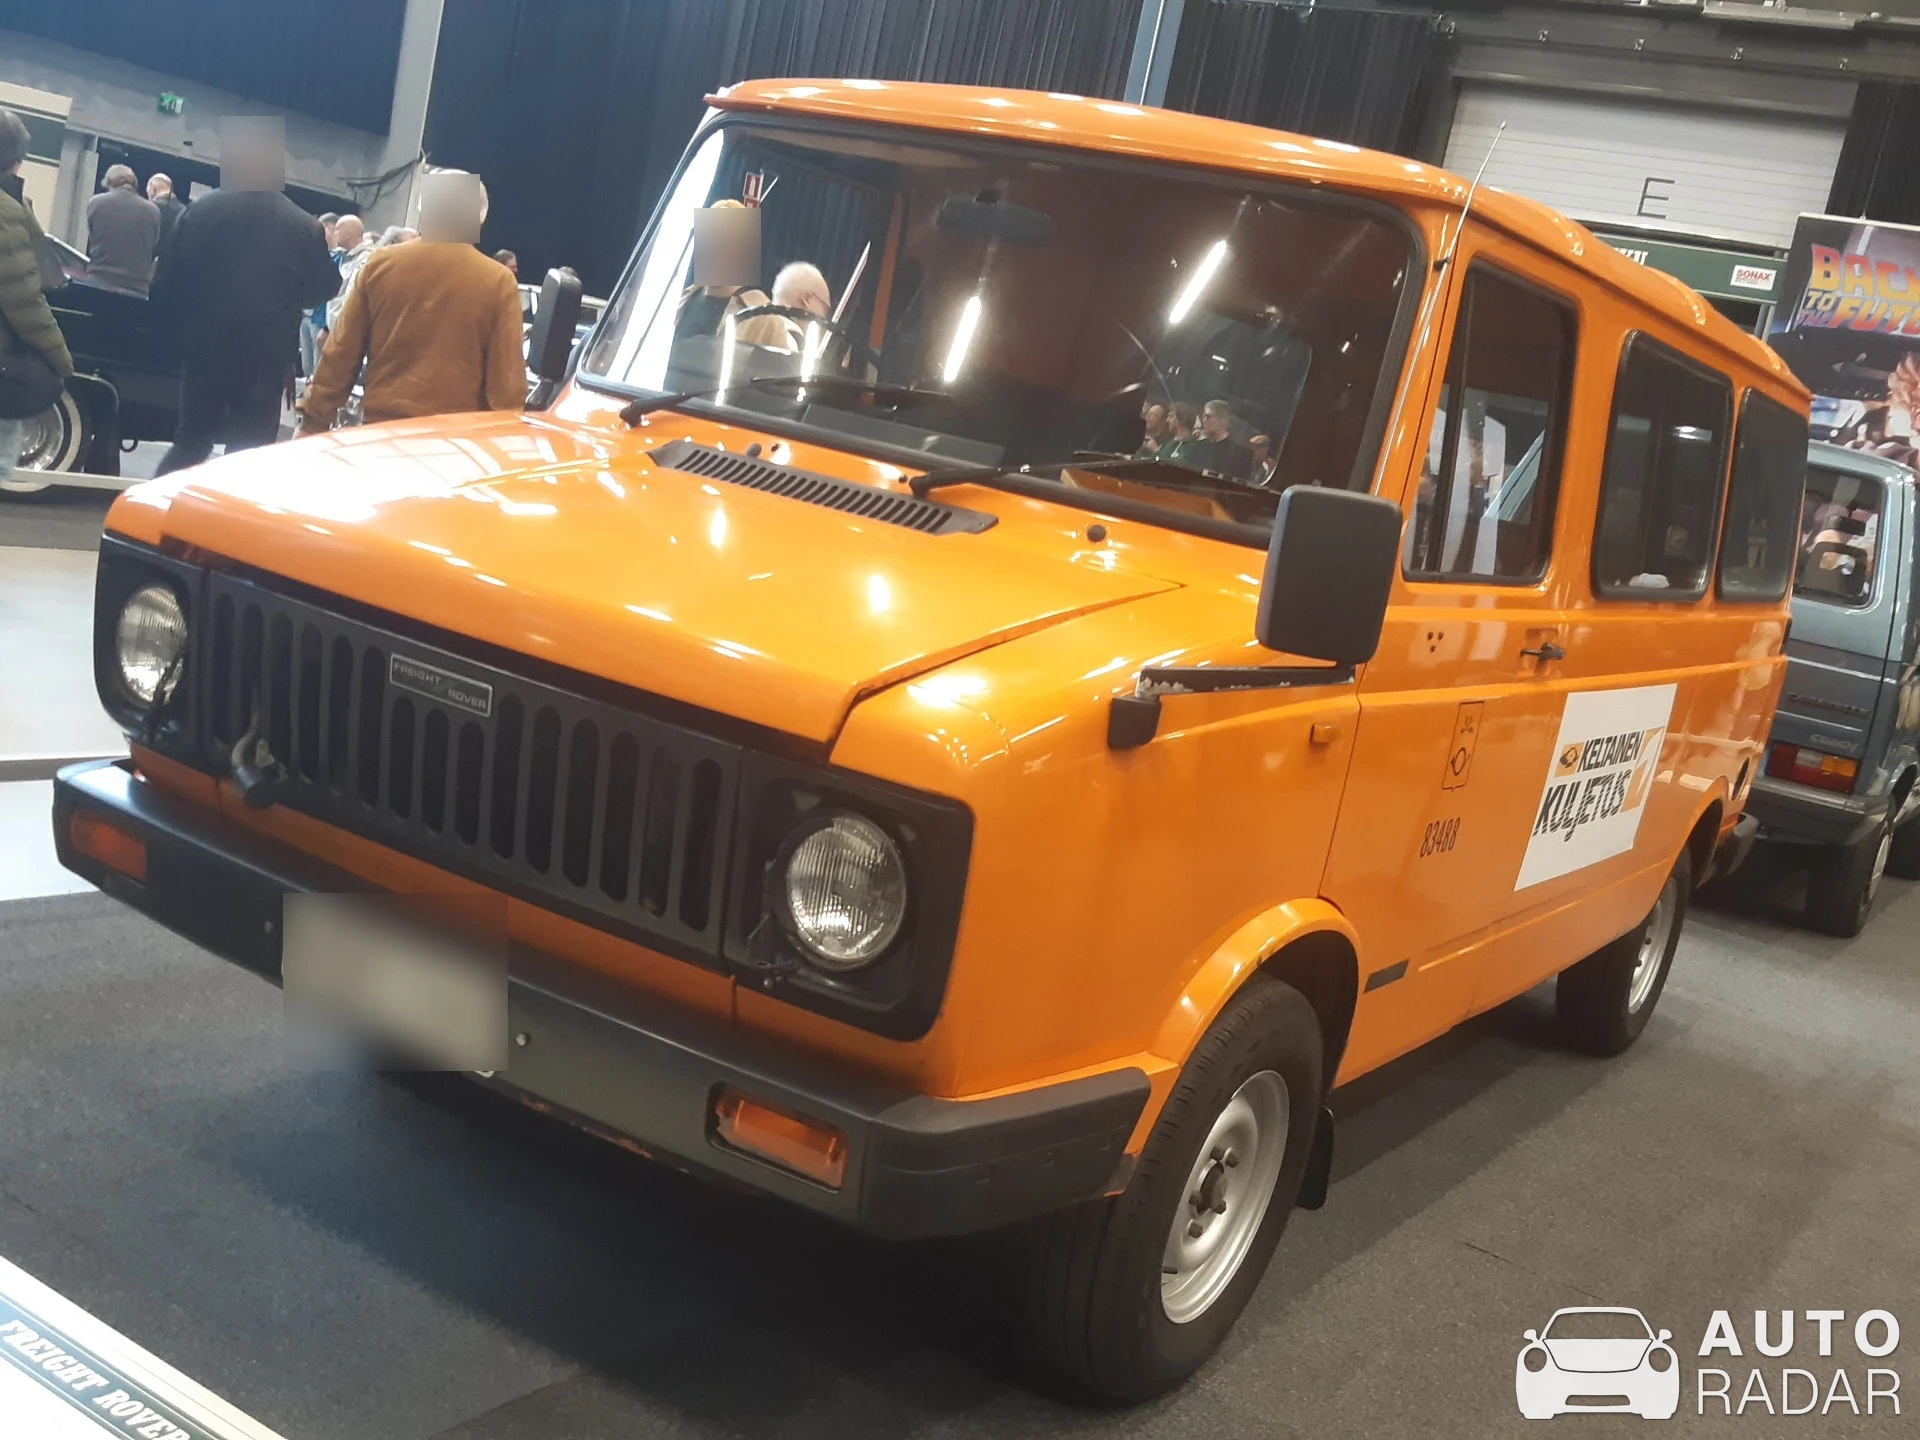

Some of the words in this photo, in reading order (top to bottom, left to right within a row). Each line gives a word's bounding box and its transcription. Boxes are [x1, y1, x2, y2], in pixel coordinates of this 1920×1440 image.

[1637, 177, 1676, 220] E
[1735, 269, 1772, 282] SONAX
[1806, 290, 1837, 312] TO
[394, 661, 442, 685] FREIGHT
[447, 688, 487, 709] ROVER
[1577, 731, 1645, 773] KELTAINEN
[1532, 768, 1632, 842] KULJETUS
[1420, 817, 1461, 858] 83488
[0, 1319, 110, 1391] FREIGHT
